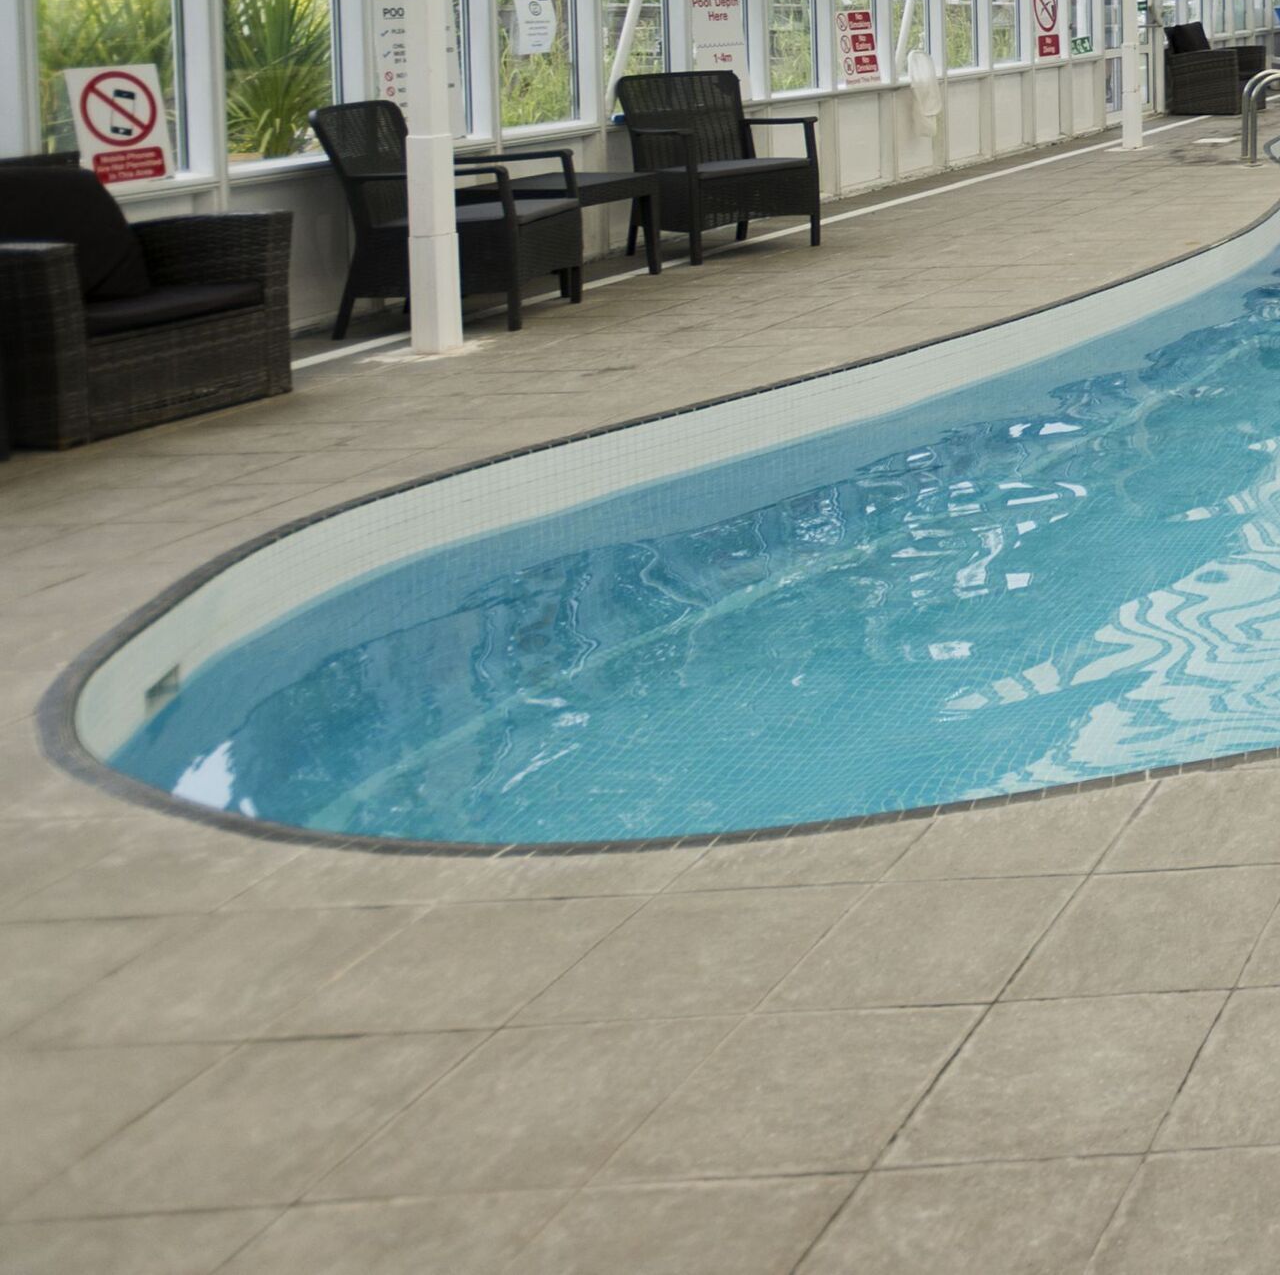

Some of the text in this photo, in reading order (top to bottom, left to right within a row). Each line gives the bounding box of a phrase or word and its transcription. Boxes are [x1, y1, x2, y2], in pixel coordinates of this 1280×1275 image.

[382, 8, 405, 17] POO
[708, 11, 728, 21] Here
[855, 42, 872, 51] Eating
